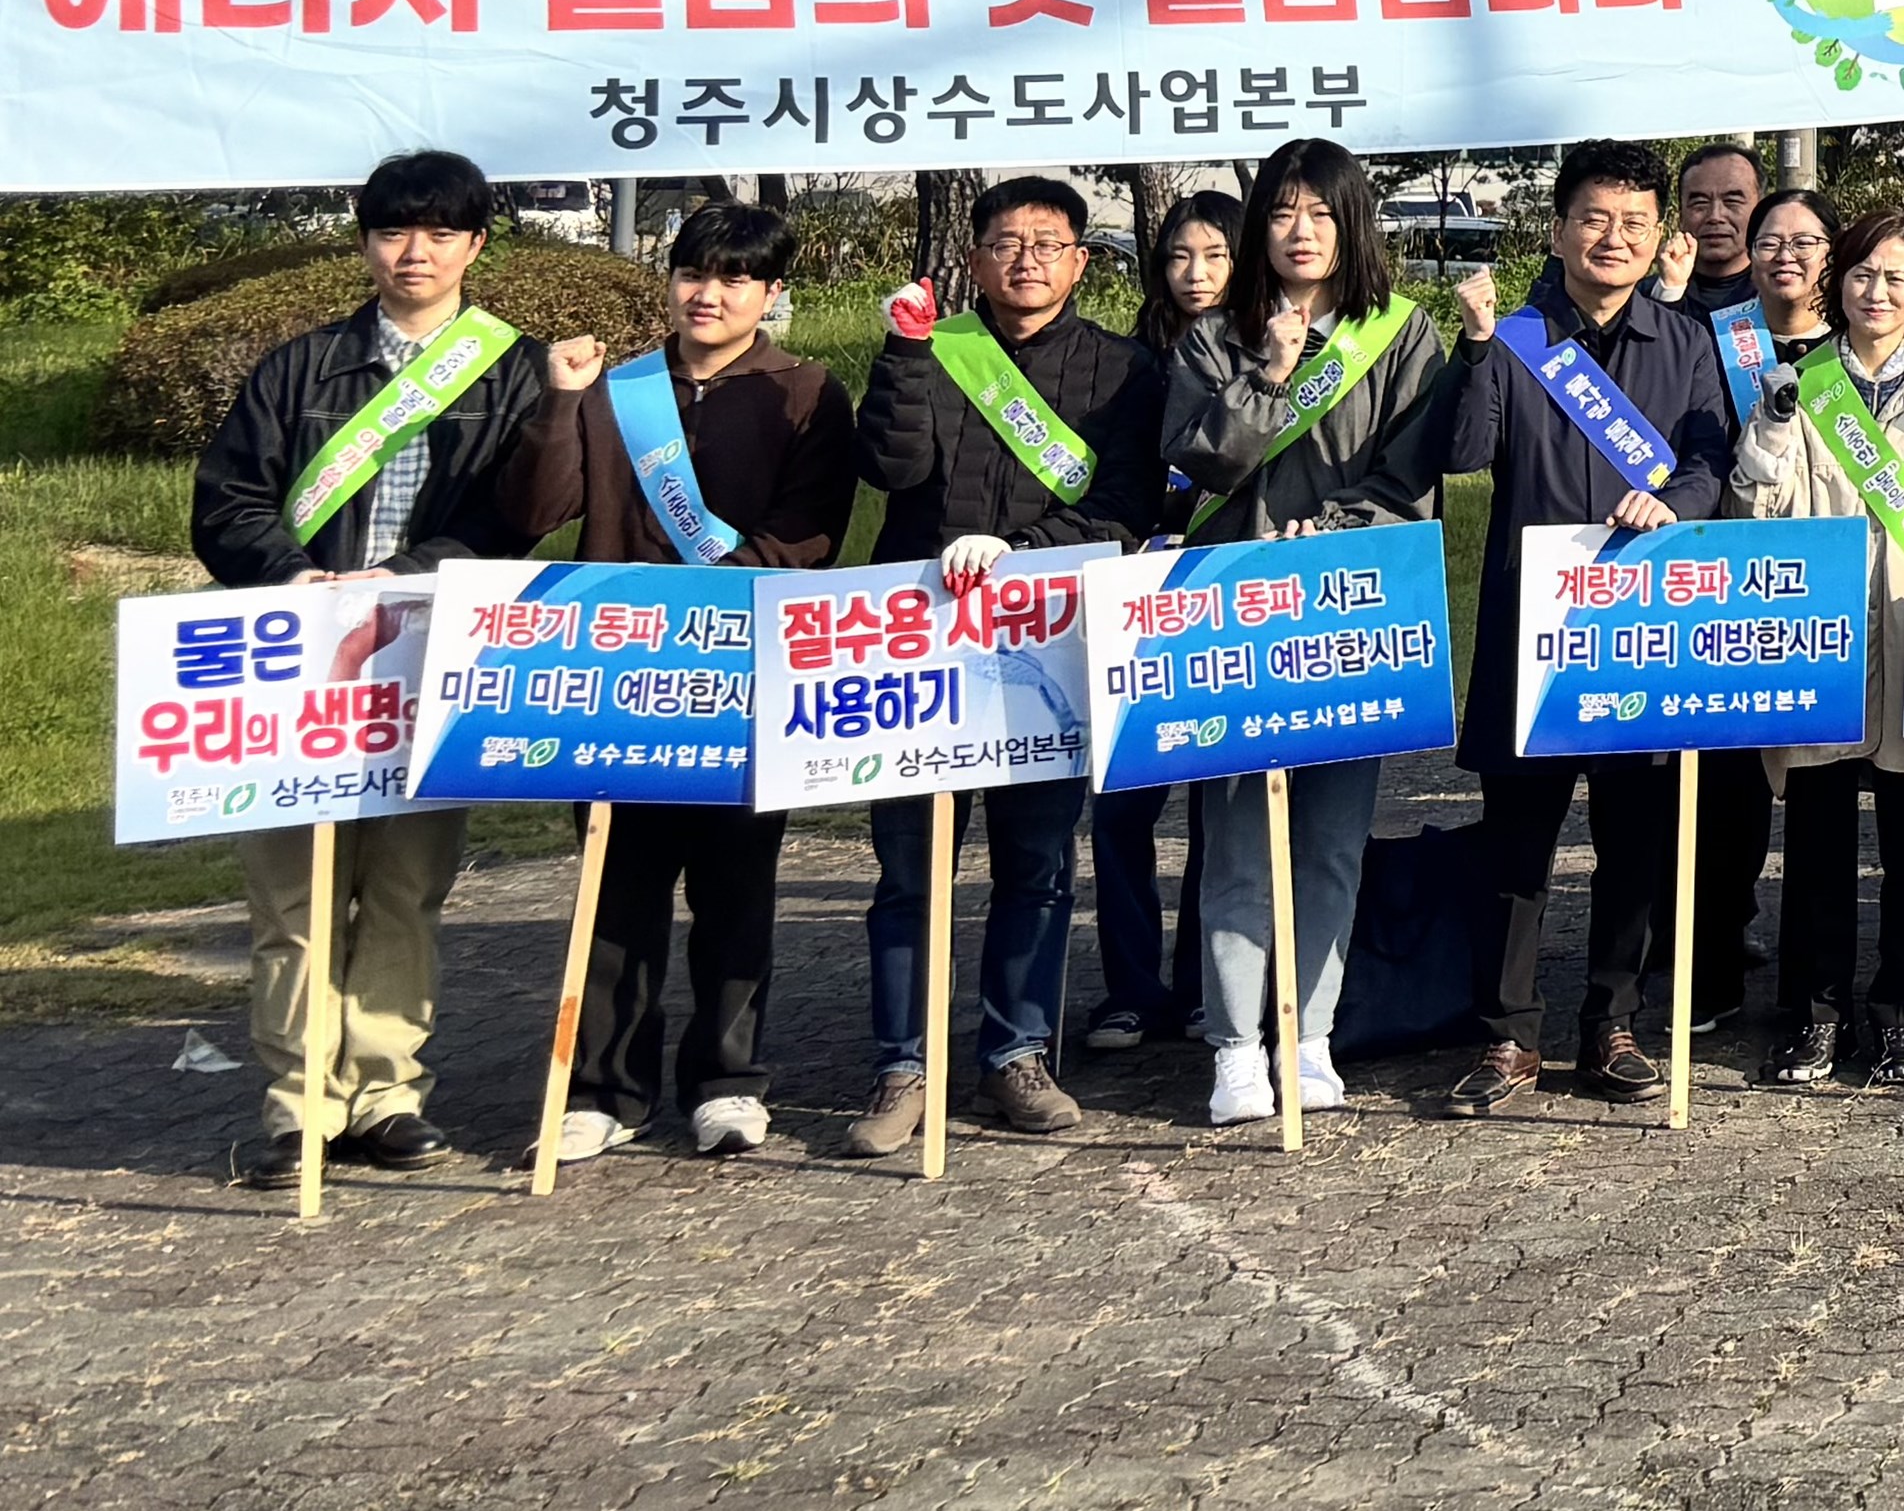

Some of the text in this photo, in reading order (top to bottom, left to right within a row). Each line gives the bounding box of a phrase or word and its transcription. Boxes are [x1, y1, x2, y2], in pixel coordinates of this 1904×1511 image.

[588, 64, 1368, 151] 청주시상수도사업본부
[1835, 412, 1880, 470] 소중한
[660, 474, 703, 538] 소중한
[1123, 568, 1383, 635] 계량기 동파 사고
[1555, 558, 1806, 605] 계량기 동파 사고
[174, 611, 302, 689] 물은
[469, 602, 752, 650] 계량기 동파 사고
[781, 587, 934, 669] 절수용
[1536, 617, 1852, 667] 미리 미리 예방합시다
[1108, 622, 1435, 698] 미리 미리 예방합시다
[440, 667, 511, 712] 미리
[528, 670, 599, 715] 미리
[785, 666, 963, 740] 사용하기
[1241, 699, 1406, 739] 상수도사업본부
[1660, 688, 1818, 716] 상수도사업본부
[138, 696, 279, 772] 우리의
[573, 741, 748, 771] 상수도사업본부
[896, 730, 1085, 777] 상수도사업본부
